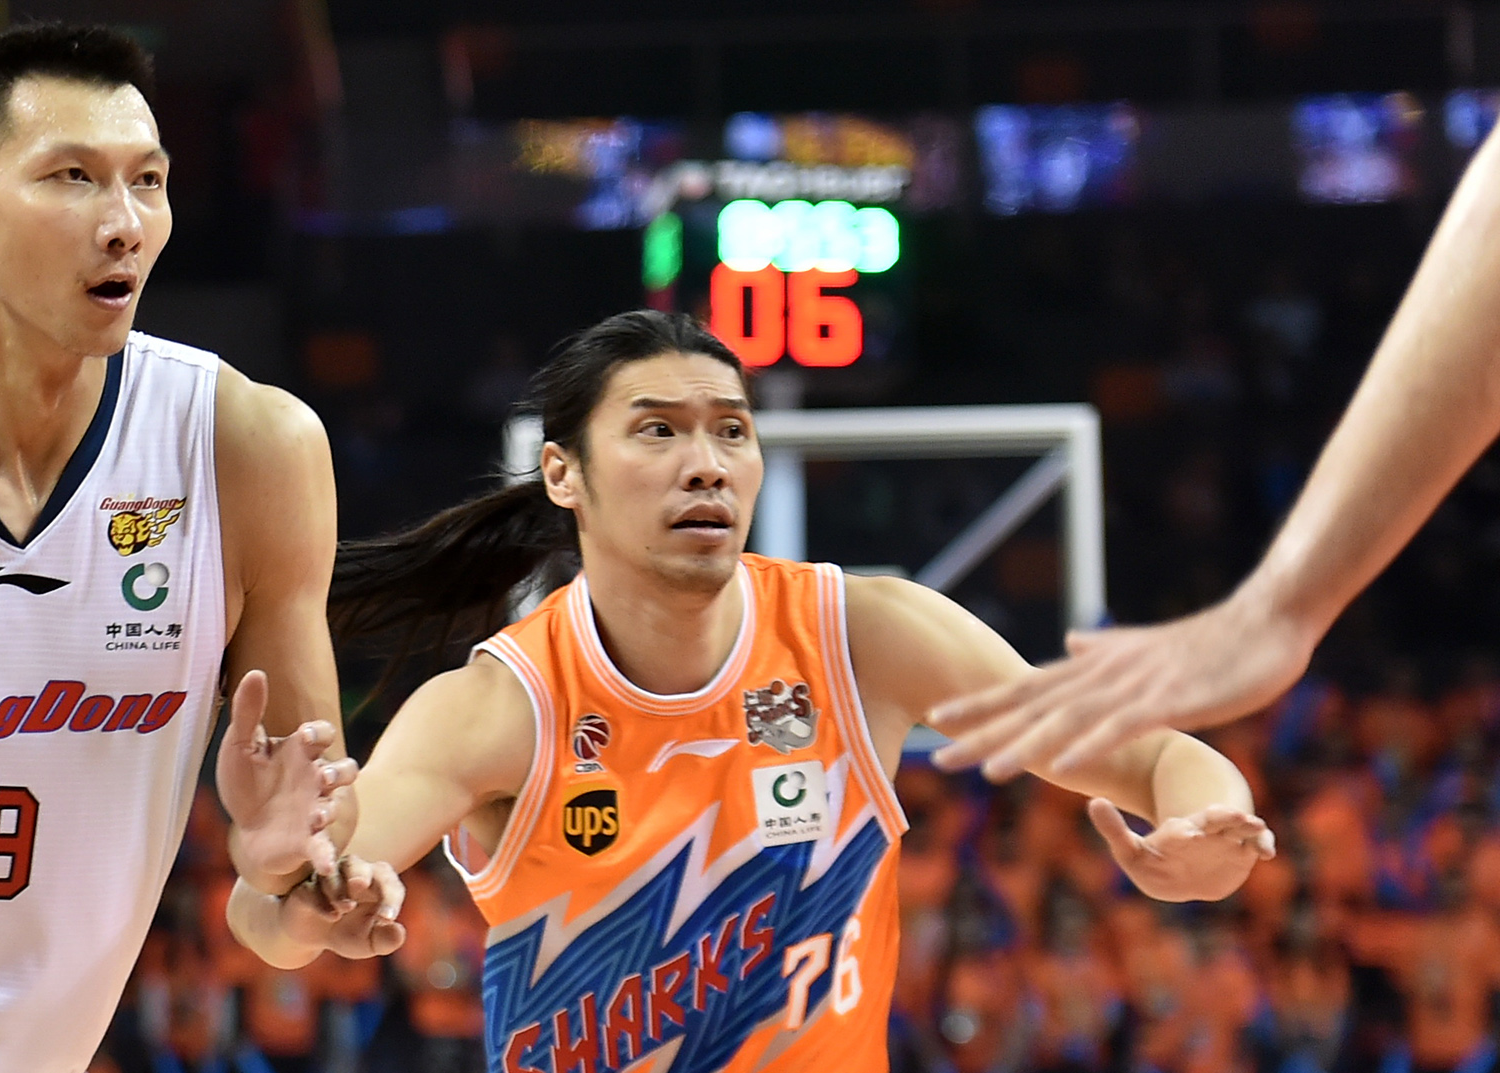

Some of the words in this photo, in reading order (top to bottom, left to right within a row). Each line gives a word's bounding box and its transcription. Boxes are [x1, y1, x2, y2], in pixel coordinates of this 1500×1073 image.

[711, 260, 863, 367] 06
[99, 496, 180, 512] GuangDong
[105, 622, 183, 639] 中国人寿
[105, 641, 148, 651] CHINA
[152, 641, 181, 651] LIFE
[565, 805, 618, 848] ups
[781, 916, 863, 1031] 76
